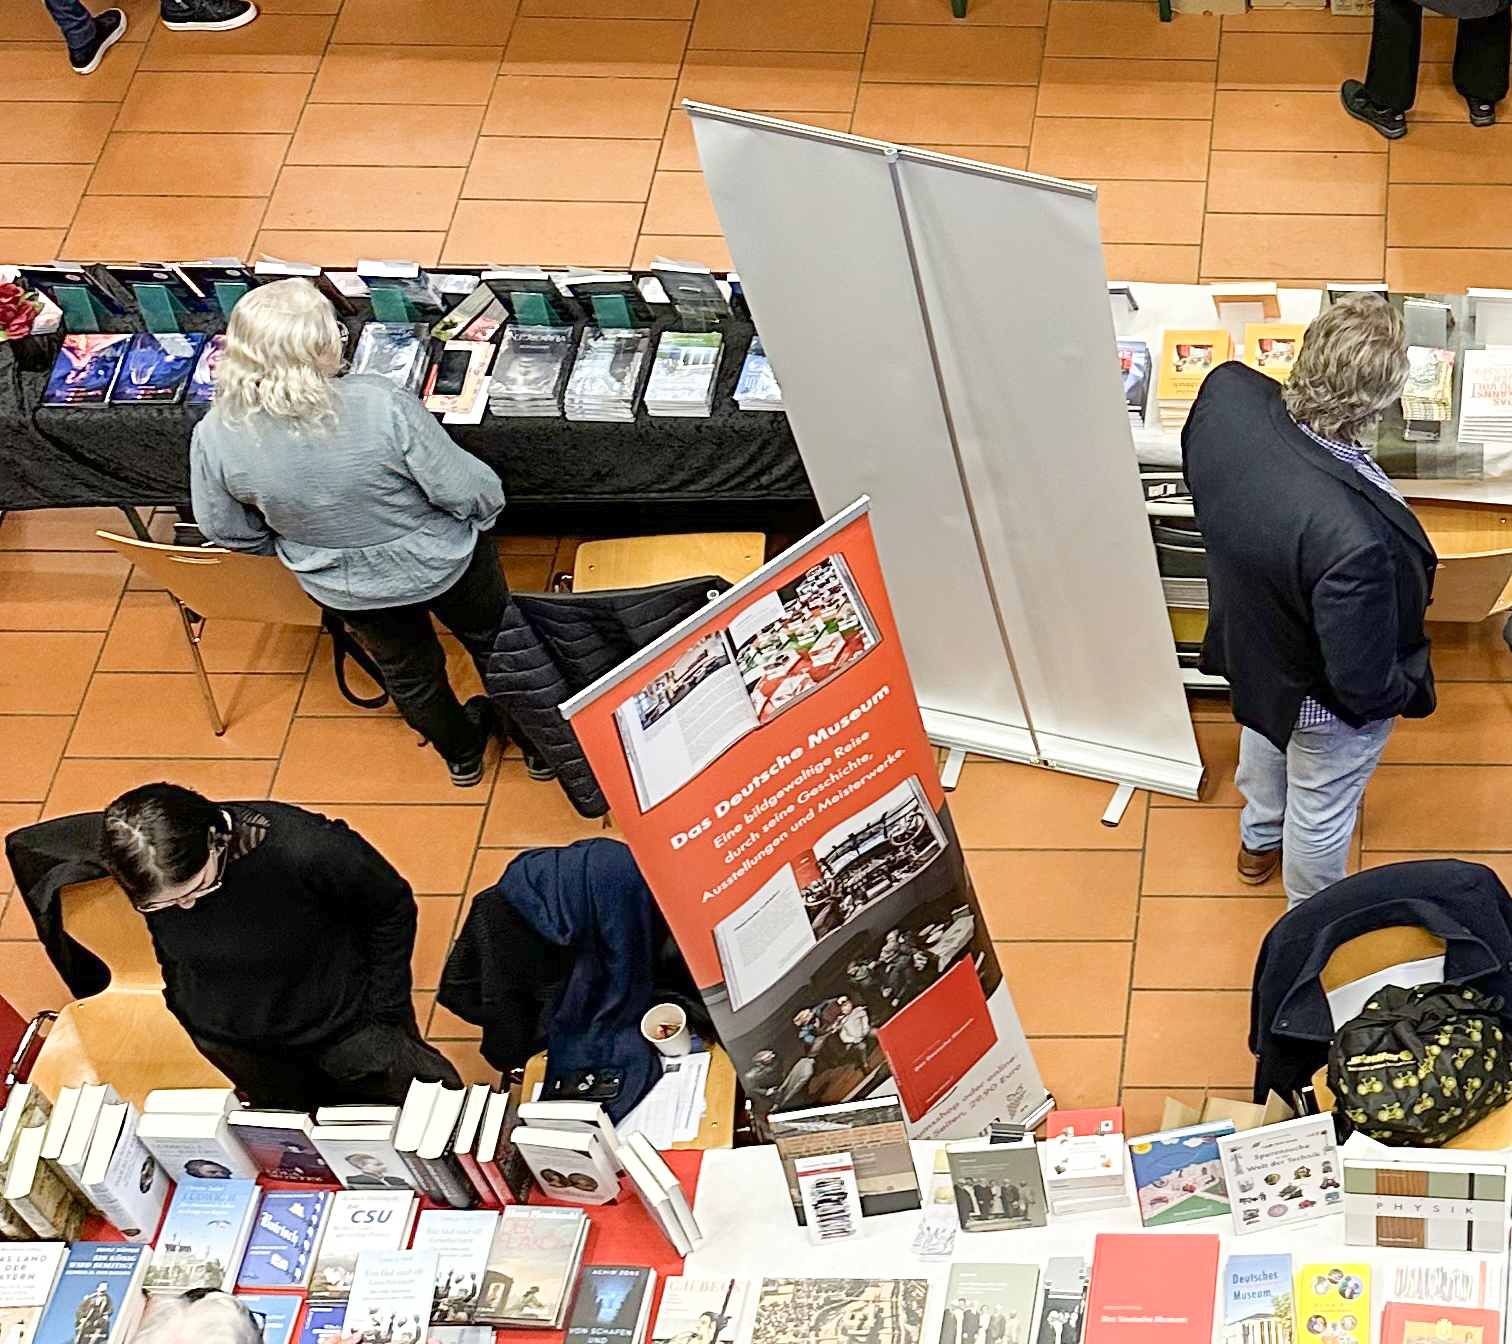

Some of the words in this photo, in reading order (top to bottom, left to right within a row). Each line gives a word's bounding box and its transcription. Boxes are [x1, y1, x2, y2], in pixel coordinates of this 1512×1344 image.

[670, 817, 713, 851] Das
[713, 746, 804, 819] Deutsche
[807, 684, 890, 749] Museum
[713, 823, 743, 849] Eine
[743, 756, 832, 825] bildgewaltige
[834, 731, 870, 759] Reise
[701, 831, 789, 904] Ausstellungen
[790, 808, 815, 833] und
[817, 748, 907, 814] Meisterwerke.
[724, 830, 761, 865] durch
[762, 804, 796, 833] seine
[797, 752, 874, 805] Geschichte,
[351, 1210, 393, 1223] CSU
[1232, 1270, 1279, 1285] Deutsches
[1233, 1289, 1272, 1301] Museum
[568, 1327, 590, 1336] VON
[590, 1327, 633, 1337] SCHAFEN
